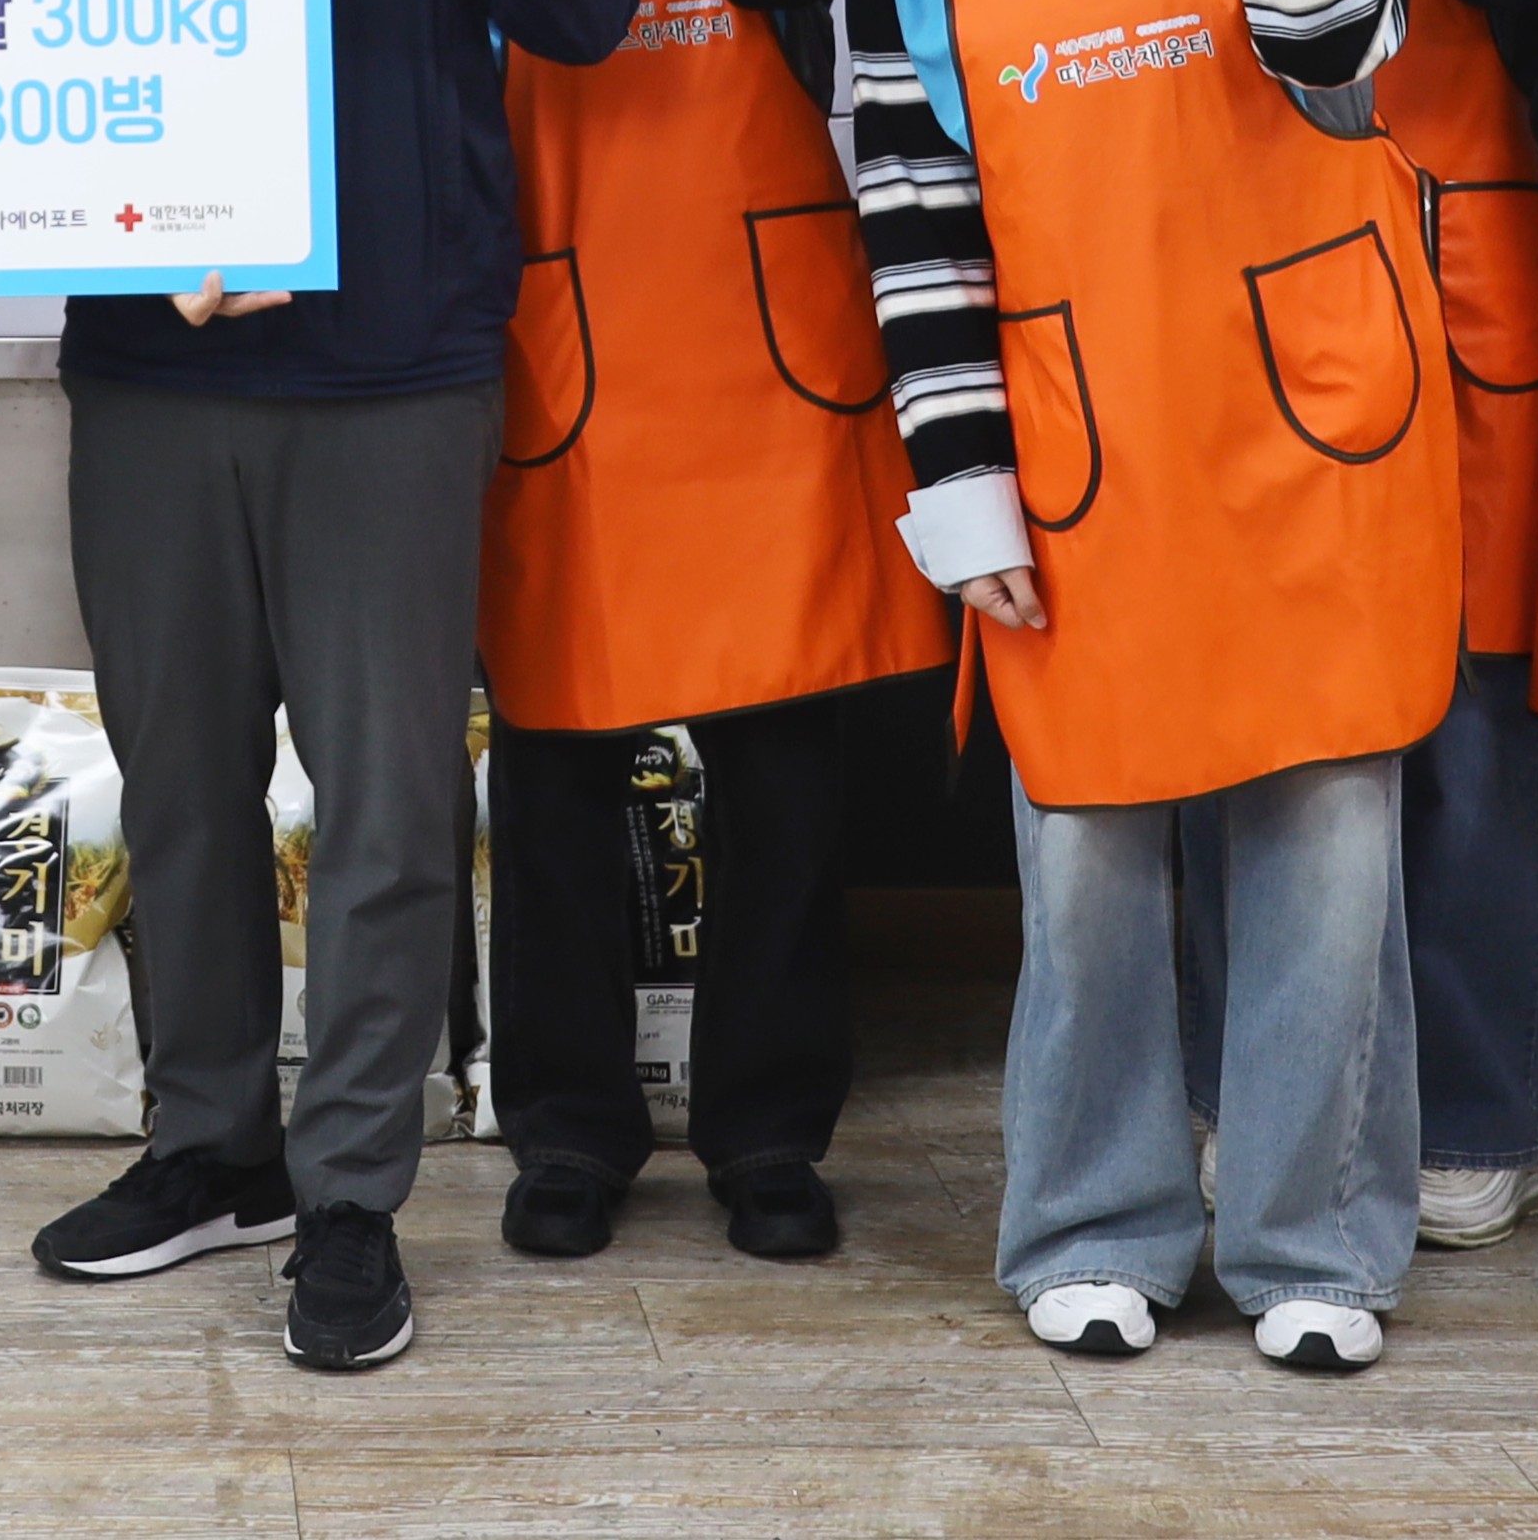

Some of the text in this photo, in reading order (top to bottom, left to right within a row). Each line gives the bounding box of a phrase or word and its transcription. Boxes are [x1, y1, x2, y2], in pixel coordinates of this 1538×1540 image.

[616, 12, 734, 51] 스한채움터
[1055, 31, 1215, 88] 따스한채움터
[148, 204, 234, 221] 대한적십자사
